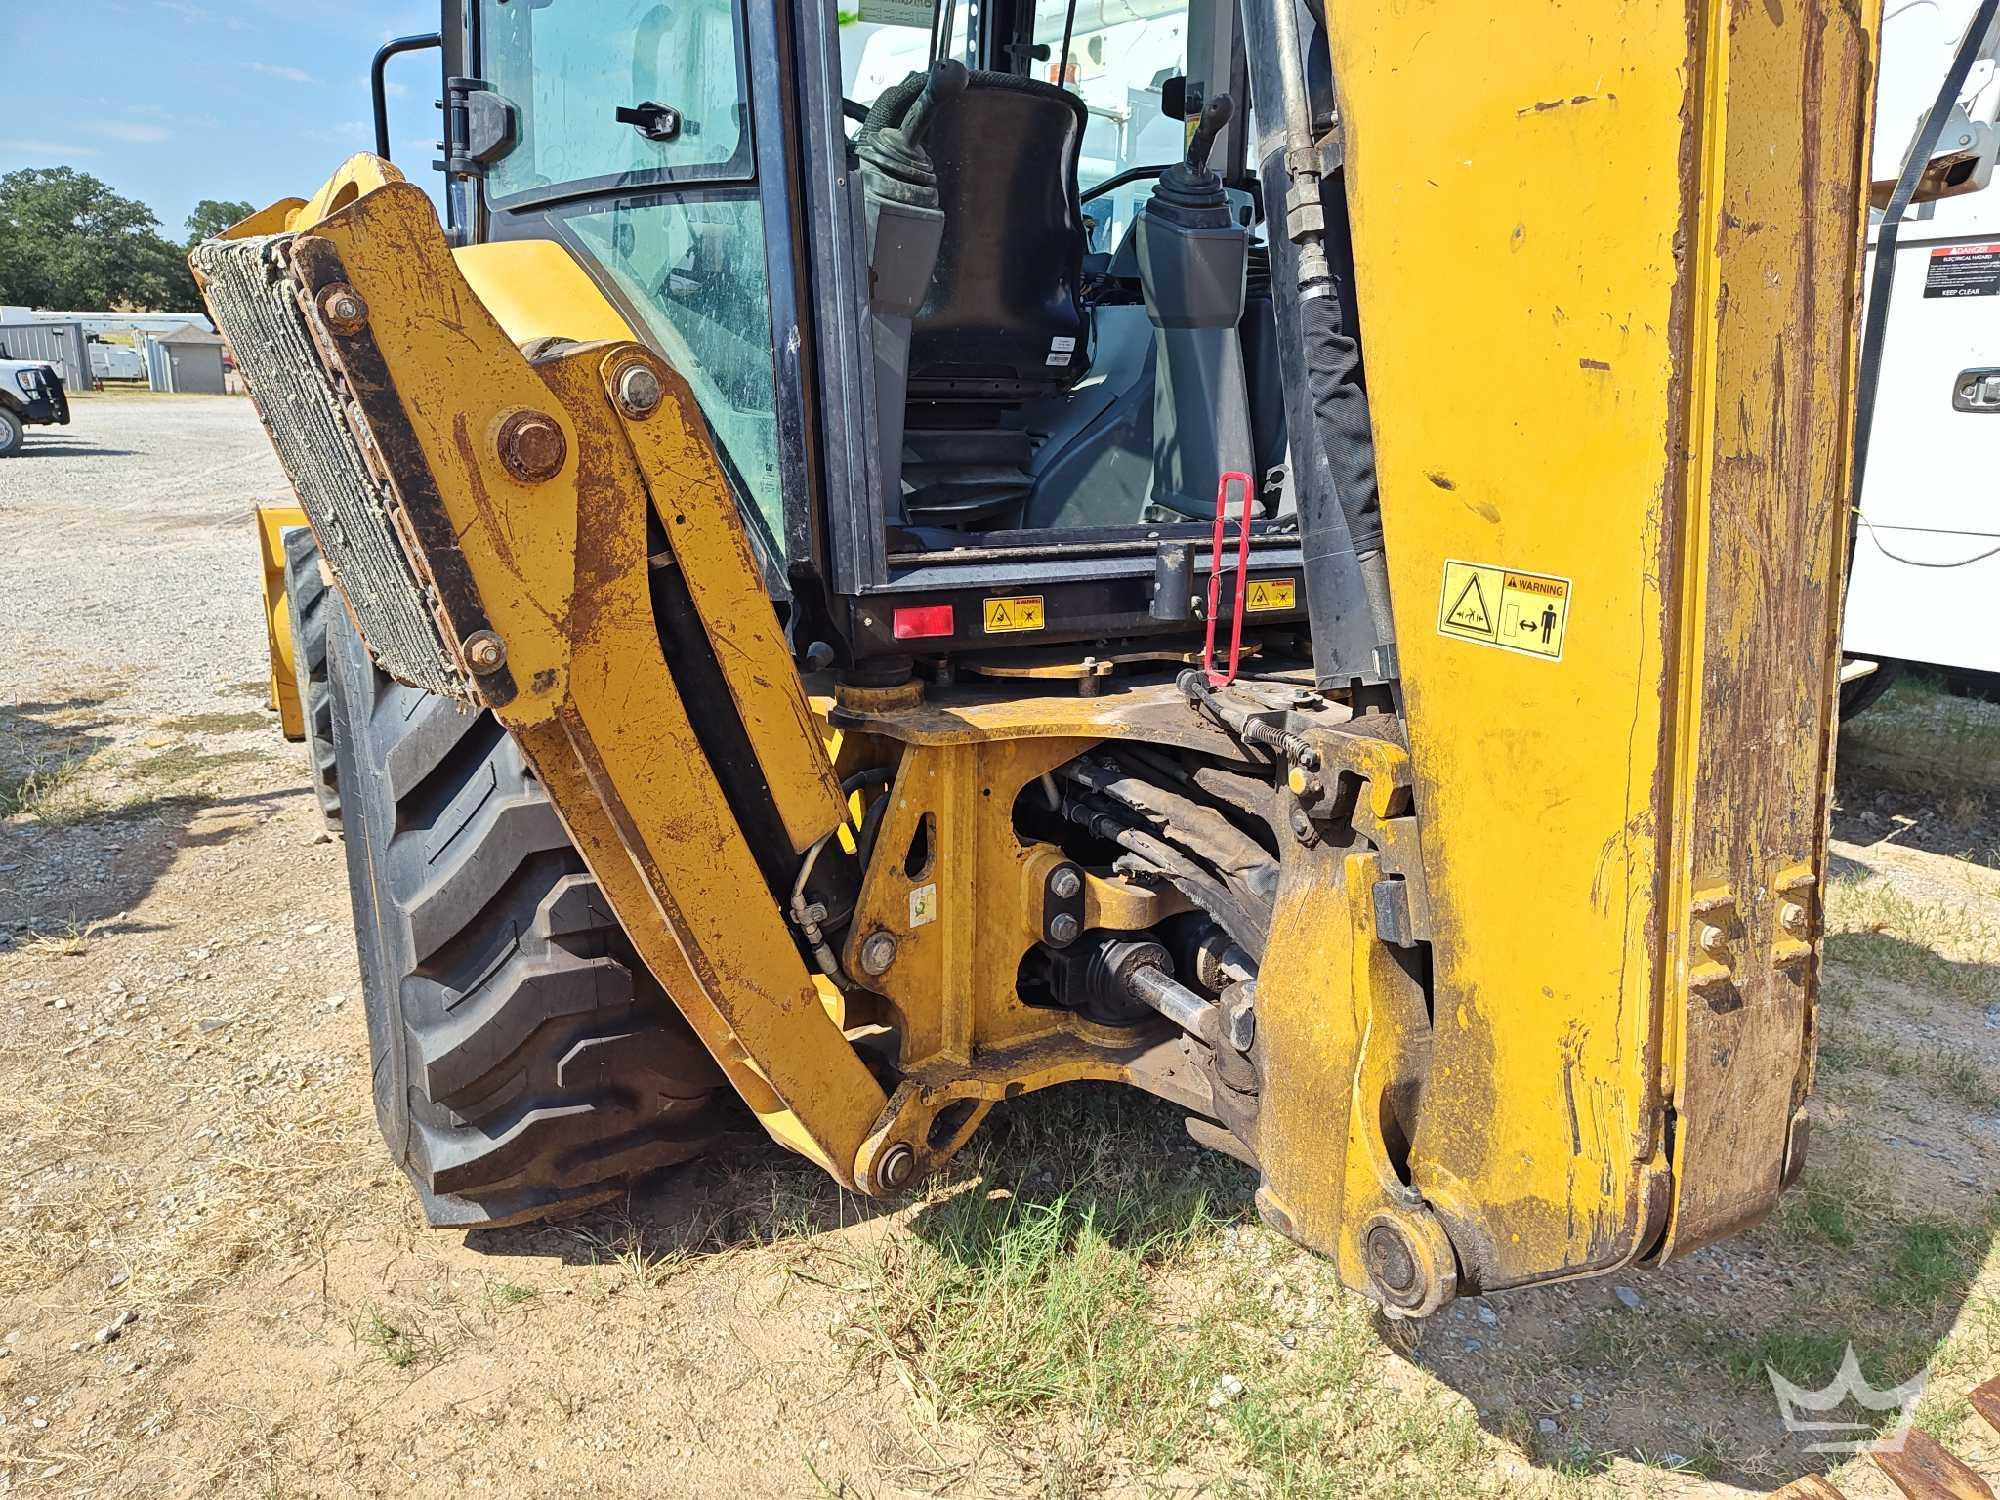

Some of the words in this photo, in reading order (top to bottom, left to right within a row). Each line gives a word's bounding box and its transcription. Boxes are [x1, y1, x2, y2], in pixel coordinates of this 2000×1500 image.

[1957, 246, 1988, 255] DANGER
[1958, 288, 1980, 296] CLEAR
[1519, 579, 1563, 597] WARNING
